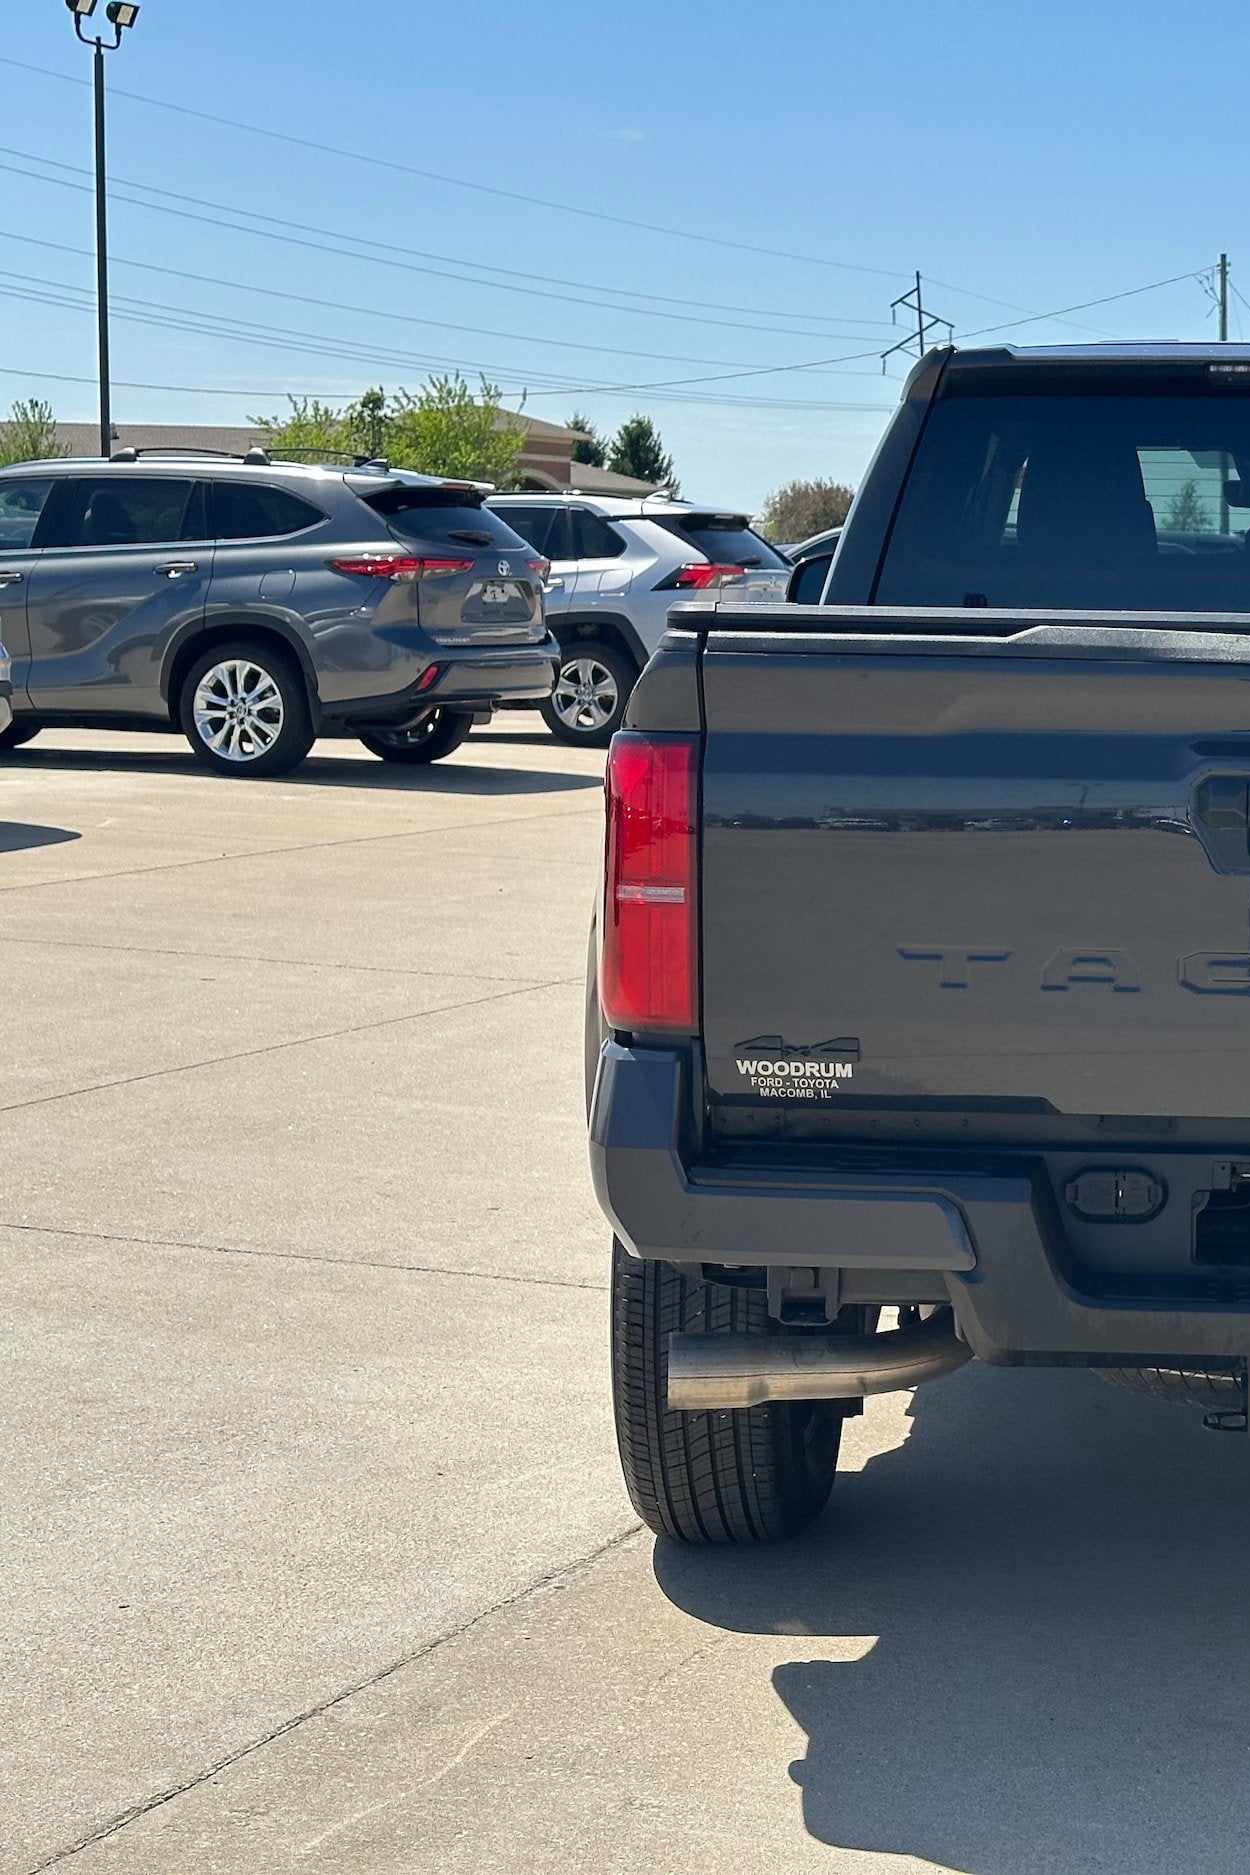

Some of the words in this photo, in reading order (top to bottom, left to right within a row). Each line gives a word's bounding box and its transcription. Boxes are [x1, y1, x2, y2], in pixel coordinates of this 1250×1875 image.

[736, 1059, 853, 1078] WOODRUM
[751, 1077, 783, 1087] FORD
[793, 1078, 839, 1089] TOYOTA
[760, 1087, 817, 1099] MACOMB,
[821, 1090, 832, 1099] IL
